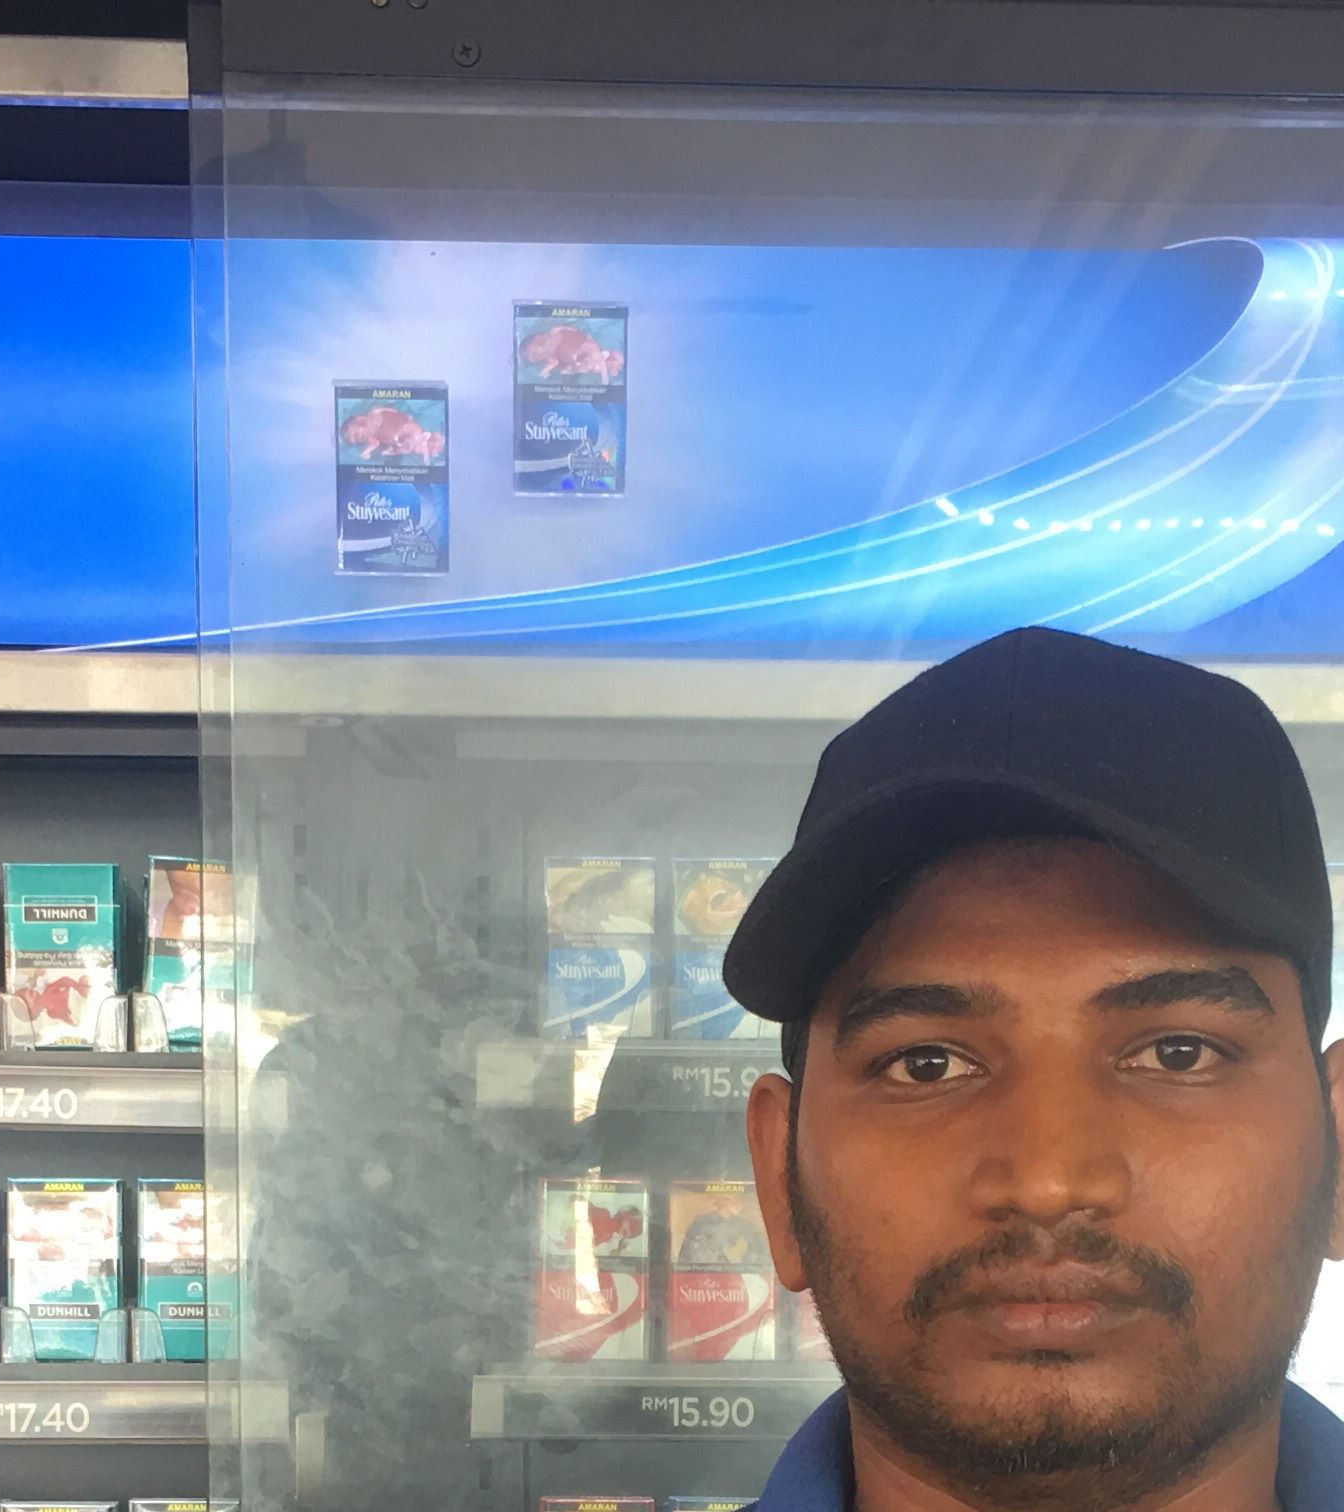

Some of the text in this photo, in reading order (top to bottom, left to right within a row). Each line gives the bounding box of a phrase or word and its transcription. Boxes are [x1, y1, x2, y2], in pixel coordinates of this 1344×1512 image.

[552, 309, 590, 317] AMARAN
[373, 390, 411, 398] AMARAN
[525, 422, 587, 442] Stuyvesant
[347, 502, 410, 524] Stuyvesant
[582, 860, 622, 868] AMARAN
[708, 862, 747, 870] AMARAN
[33, 908, 87, 919] DUNHILL
[556, 963, 621, 980] Stuyvesant
[44, 1183, 84, 1192] AMARAN
[680, 1287, 743, 1303] Stuyvesant
[38, 1307, 91, 1317] DUNHILL
[642, 1396, 755, 1428] RM15.90
[578, 1504, 617, 1512] AMARAN
